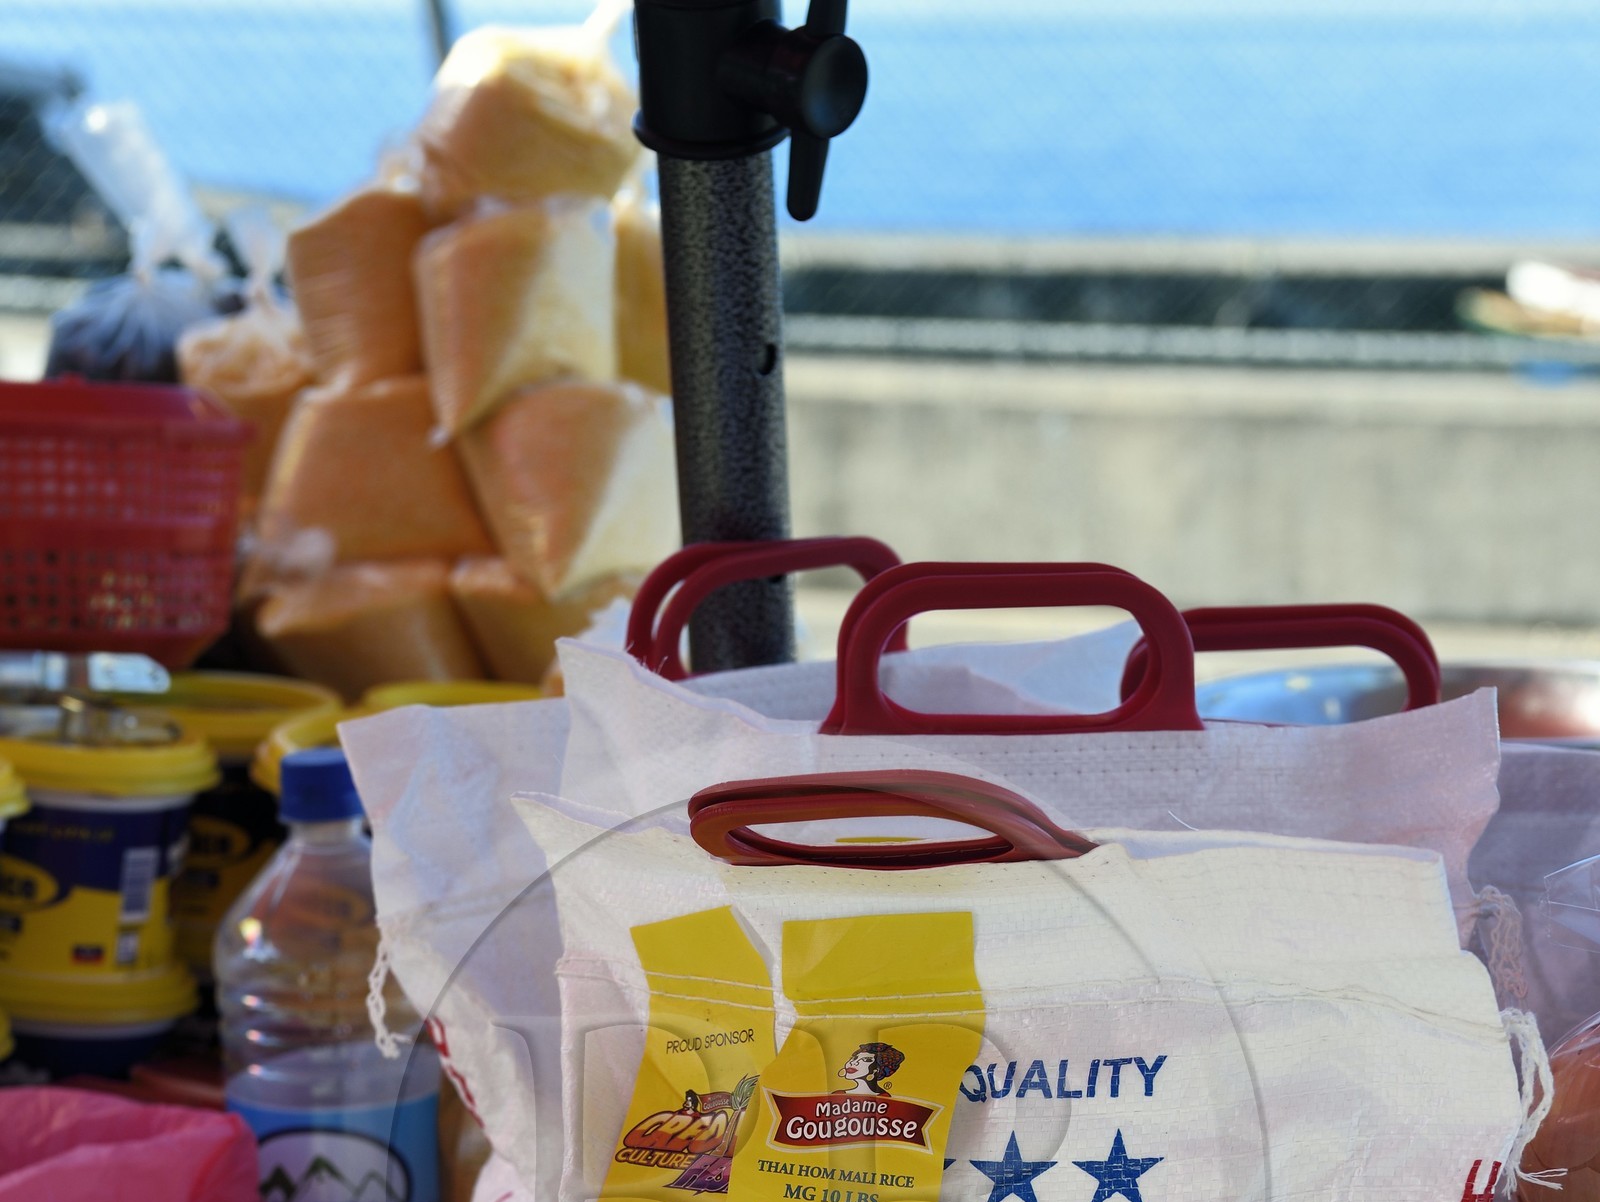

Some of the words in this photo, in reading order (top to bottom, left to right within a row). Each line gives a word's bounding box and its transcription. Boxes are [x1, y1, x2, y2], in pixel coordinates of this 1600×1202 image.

[665, 1037, 702, 1055] PROUD
[704, 1028, 755, 1049] SPONSOR
[958, 1055, 1168, 1103] QUALITY
[815, 1100, 888, 1118] Madame
[785, 1115, 919, 1140] Gougousse
[615, 1148, 698, 1170] CULTURE
[757, 1159, 795, 1175] THAI
[796, 1164, 836, 1180] HOM
[837, 1170, 877, 1185] MALI
[879, 1174, 916, 1189] RICE
[783, 1183, 817, 1202] MG
